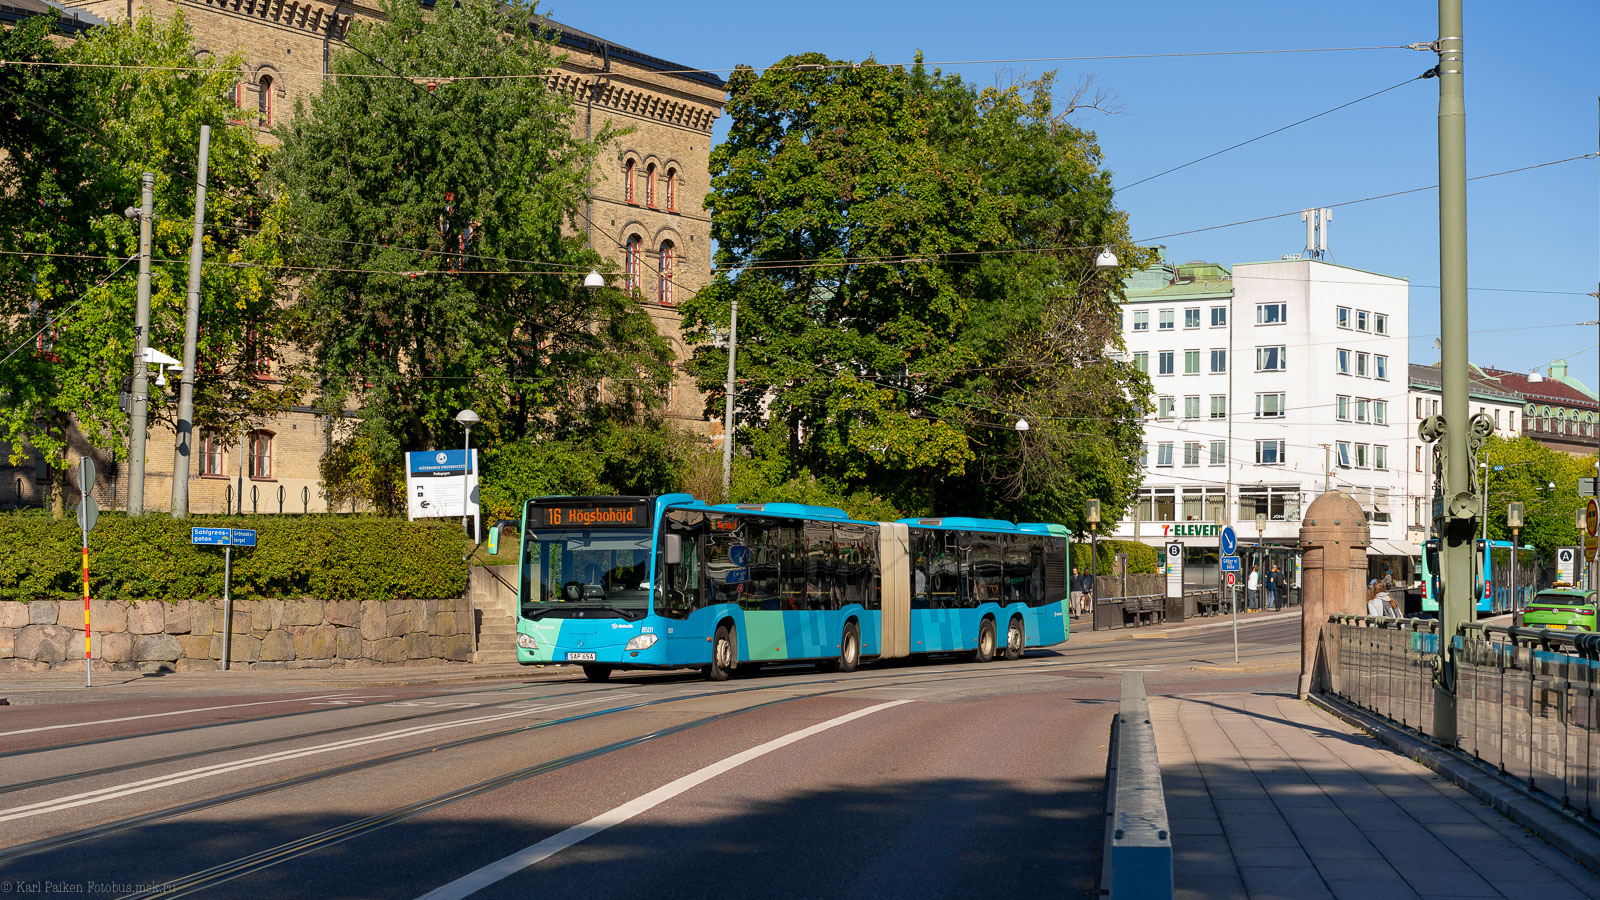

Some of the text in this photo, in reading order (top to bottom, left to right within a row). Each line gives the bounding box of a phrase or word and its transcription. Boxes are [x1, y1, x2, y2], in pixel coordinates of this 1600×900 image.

[548, 507, 633, 525] 16 Högsbohöjd
[1171, 546, 1178, 555] B
[1562, 551, 1570, 561] A
